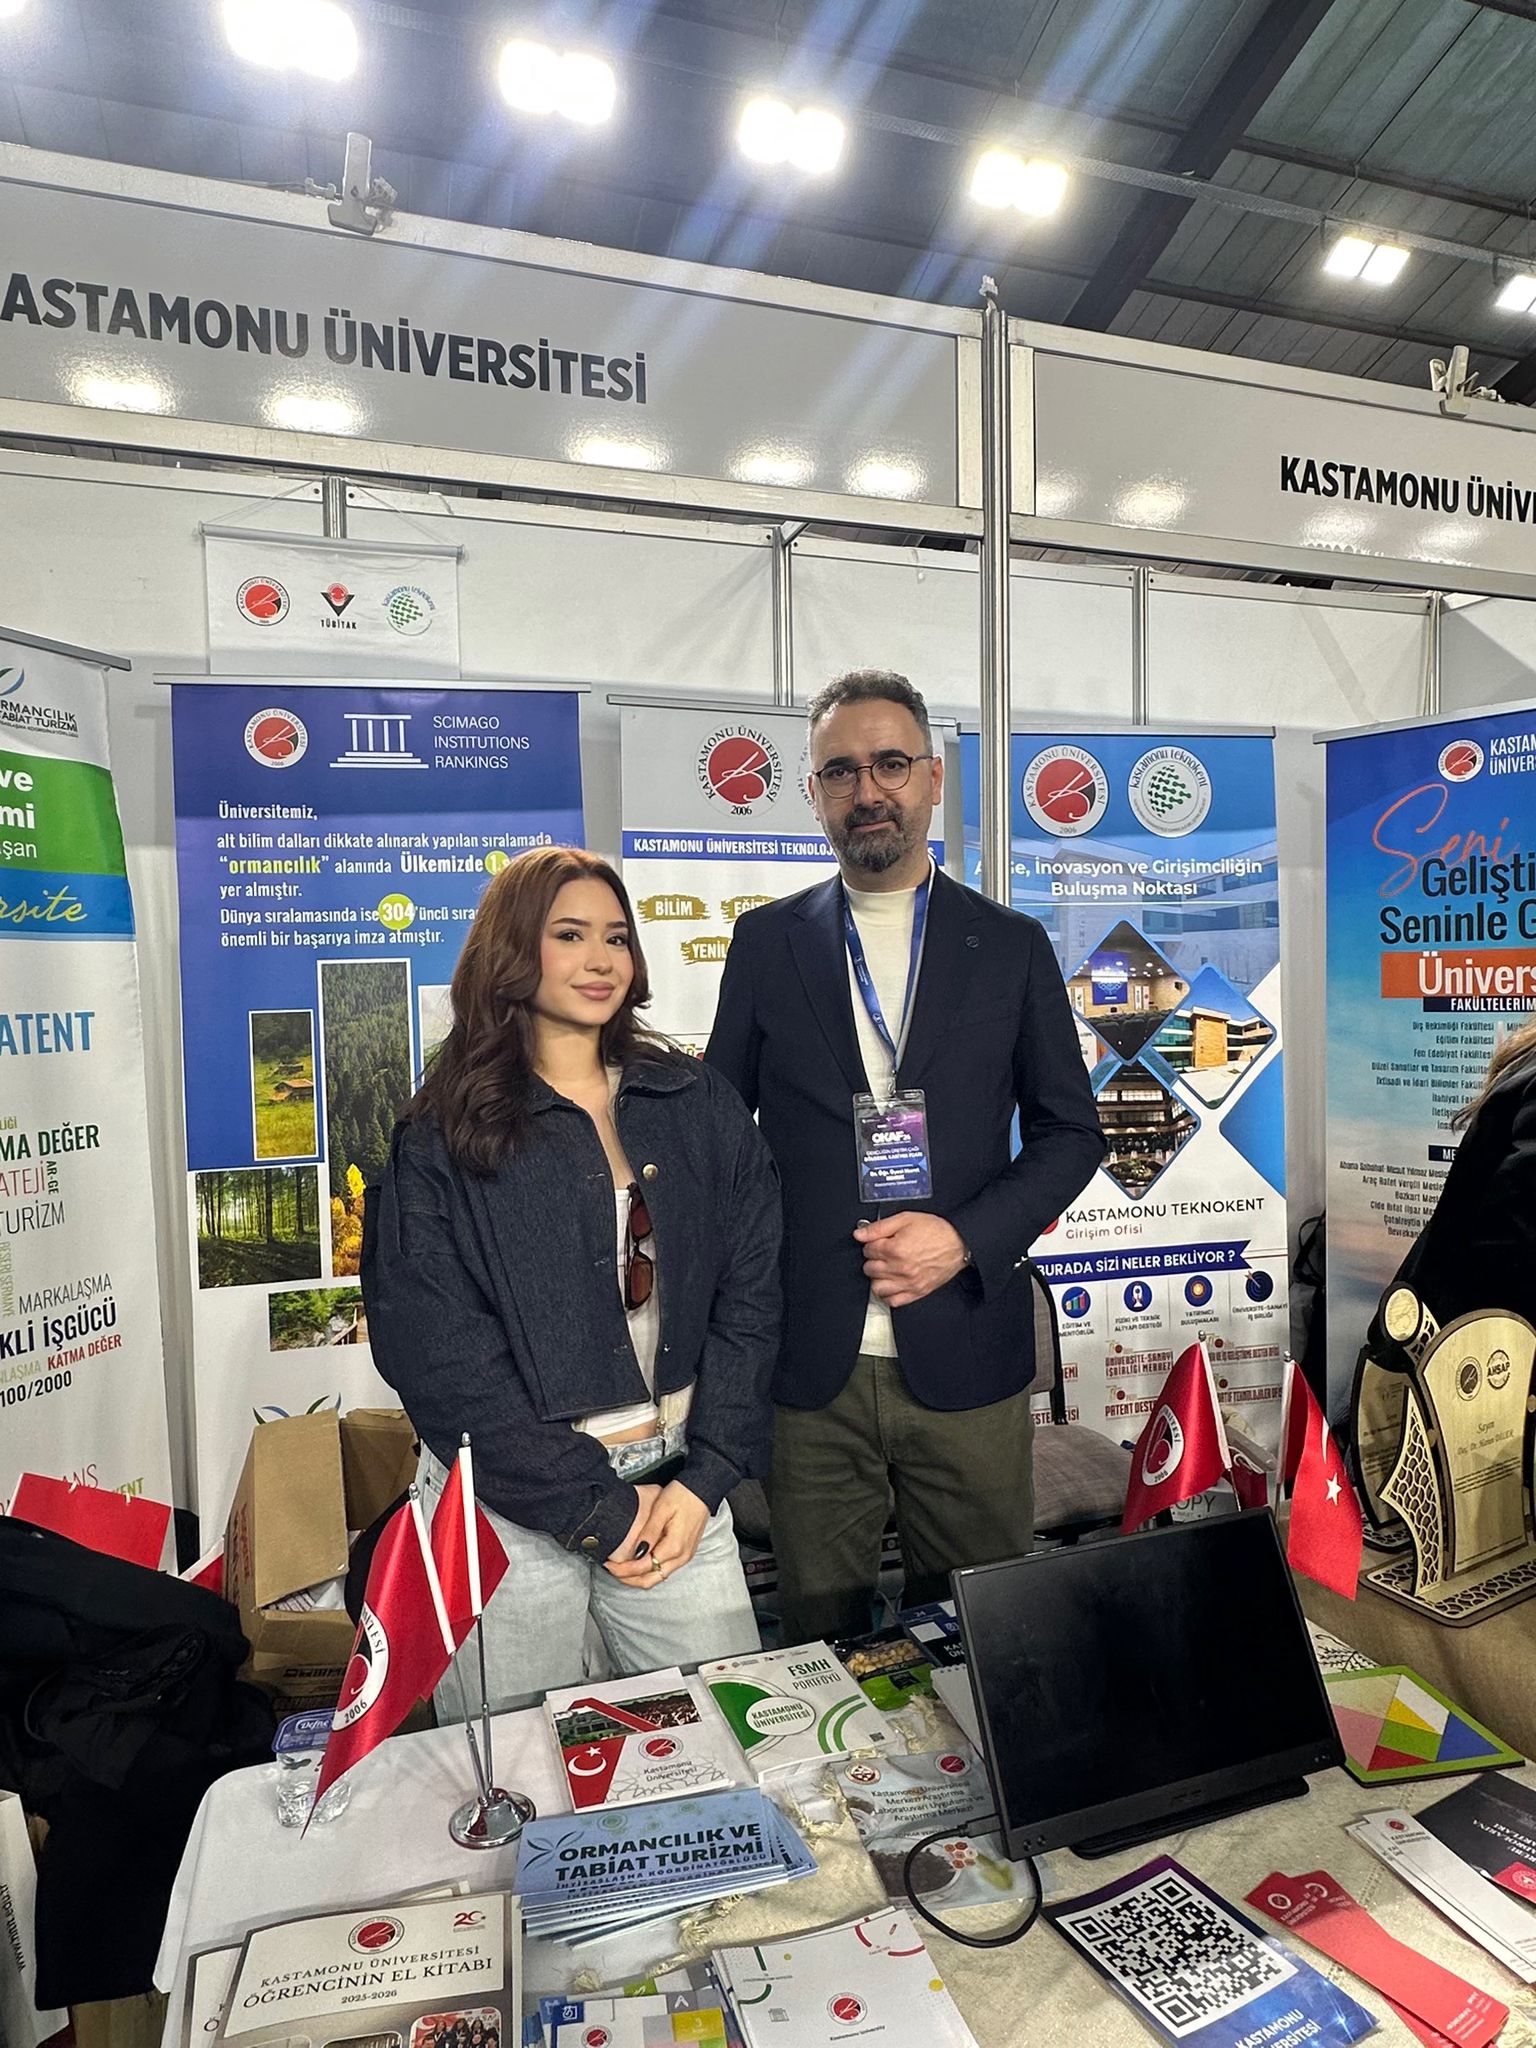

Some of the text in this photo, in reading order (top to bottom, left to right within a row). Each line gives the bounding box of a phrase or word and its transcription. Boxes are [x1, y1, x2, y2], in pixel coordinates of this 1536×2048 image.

[324, 308, 647, 405] ÜNİVERSİTESİ
[1281, 455, 1459, 513] KASTAMONU
[321, 619, 357, 630] TÜBİTAK
[433, 715, 500, 729] SCIMAGO
[434, 736, 530, 750] INSTITUTIONS
[434, 756, 509, 769] RANKINGS
[698, 724, 783, 802] KASTAMONU ÜNİVERSİTESİ
[1130, 749, 1208, 790] kastamonu teknokent
[1490, 755, 1536, 776] ÜNİVER
[1029, 747, 1106, 808] KASTAMONU ÜNİVERSİTESİ
[219, 801, 318, 821] Üniversitemiz,
[731, 806, 752, 815] 2006
[217, 832, 552, 851] alt bilim dalları dikkate alınarak yapılan sıralamada
[634, 838, 703, 852] KASTAMONU
[706, 838, 778, 855] ÜNİVERSİTESİ
[1372, 783, 1521, 898] Seni
[334, 859, 392, 874] alanında
[400, 851, 484, 873] Ülkemizde
[1035, 857, 1263, 878] İnovasyon ve Girişimciliğin
[219, 882, 302, 900] yer almıştır.
[1051, 881, 1198, 899] Buluşma Noktası
[220, 908, 261, 925] Dünya
[264, 908, 357, 923] sıralamasında
[360, 908, 379, 922] ise
[655, 899, 692, 916] BİLİM
[1380, 898, 1536, 944] Seninle G
[221, 929, 445, 949] önemli bir başarıya imza atmıştır.
[692, 939, 728, 958] YENİL
[38, 1121, 100, 1156] DEĞER
[46, 1160, 59, 1195] AR-GE
[1065, 1198, 1265, 1224] KASTAMONU TEKNOKENT
[1066, 1224, 1143, 1240] Girişim Ofisi
[1037, 1249, 1236, 1277] BURADA SİZİ NELER BEKLİYOR ?
[18, 1272, 113, 1315] MARKALAŞMA
[43, 1296, 118, 1351] İŞGÜCÜ
[47, 1334, 122, 1371] KATMA DEĞER
[787, 1659, 832, 1677] FSMH
[343, 1700, 368, 1723] 2006
[752, 1703, 803, 1720] KASTAMONU
[753, 1710, 811, 1729] ÜNİVERSİTESİ
[642, 1760, 693, 1775] Kastamonu
[646, 1767, 698, 1783] Üniversitesi
[559, 1823, 761, 1862] ORMANCILIK VE
[555, 1855, 650, 1882] TABİAT
[655, 1837, 763, 1865] TURİZMİ
[260, 1945, 481, 1988] KASTAMONU ÜNİVERSİTESİ
[243, 1957, 493, 2009] ÖĞRENCİNİN EL KİTABI
[341, 1989, 398, 2005] 2025-2026
[1235, 2009, 1304, 2048] KASTAMONU
